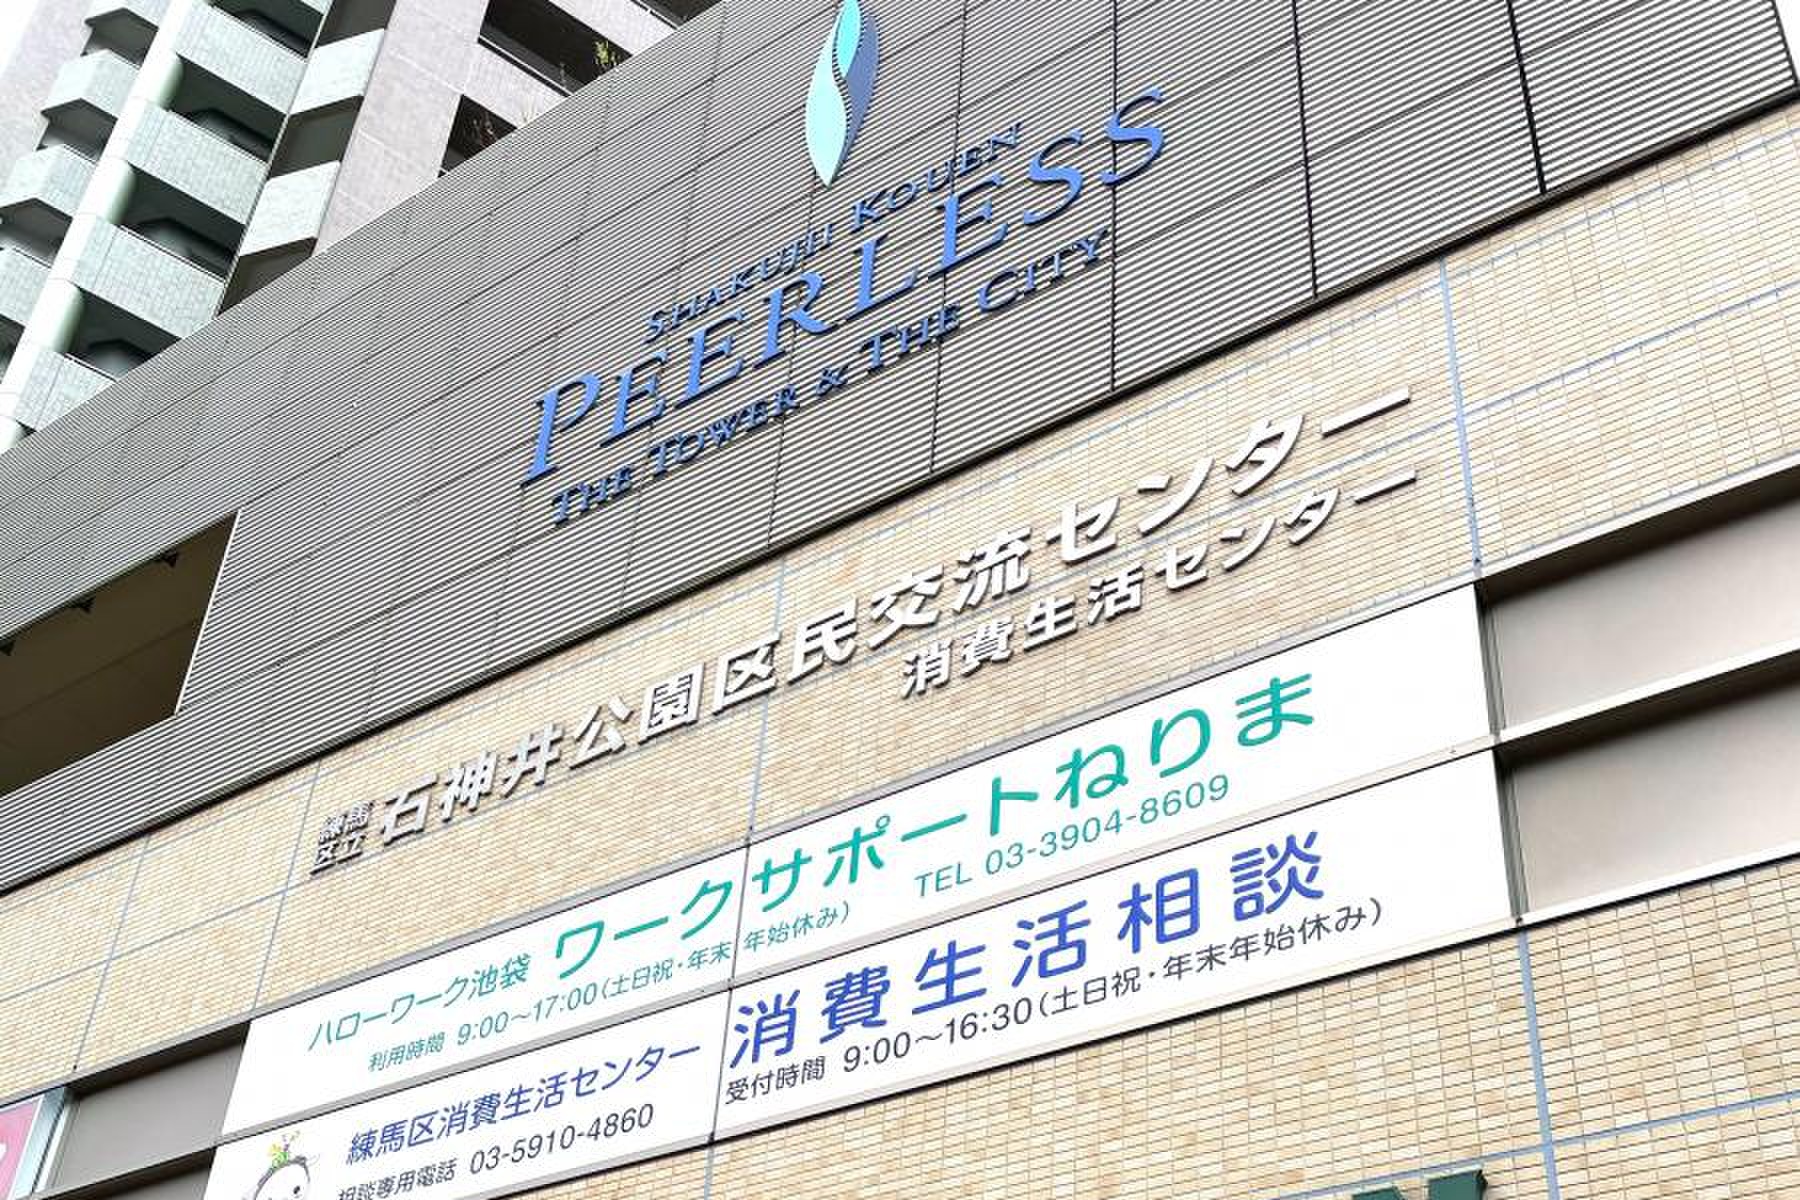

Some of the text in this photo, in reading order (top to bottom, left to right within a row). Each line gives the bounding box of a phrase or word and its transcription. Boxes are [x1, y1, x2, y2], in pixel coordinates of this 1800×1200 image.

[522, 88, 1166, 487] PEERLESS
[850, 122, 1024, 232] KOUEN
[550, 226, 1108, 527] THE TOWER & THE CITY
[380, 386, 1411, 846] 石神井公園区民交流センター
[901, 469, 1417, 699] 消費生活センター
[307, 673, 1313, 1051] ハローワーク池袋 ワークサポートねりま
[914, 774, 1229, 897] TEL 03-3904-8609
[345, 831, 1324, 1166] 練馬区消費生活センター 消費生活相談
[368, 1032, 446, 1072] 利用時間
[725, 1055, 826, 1106] 受付時間
[470, 1103, 654, 1175] 03-5910-4860
